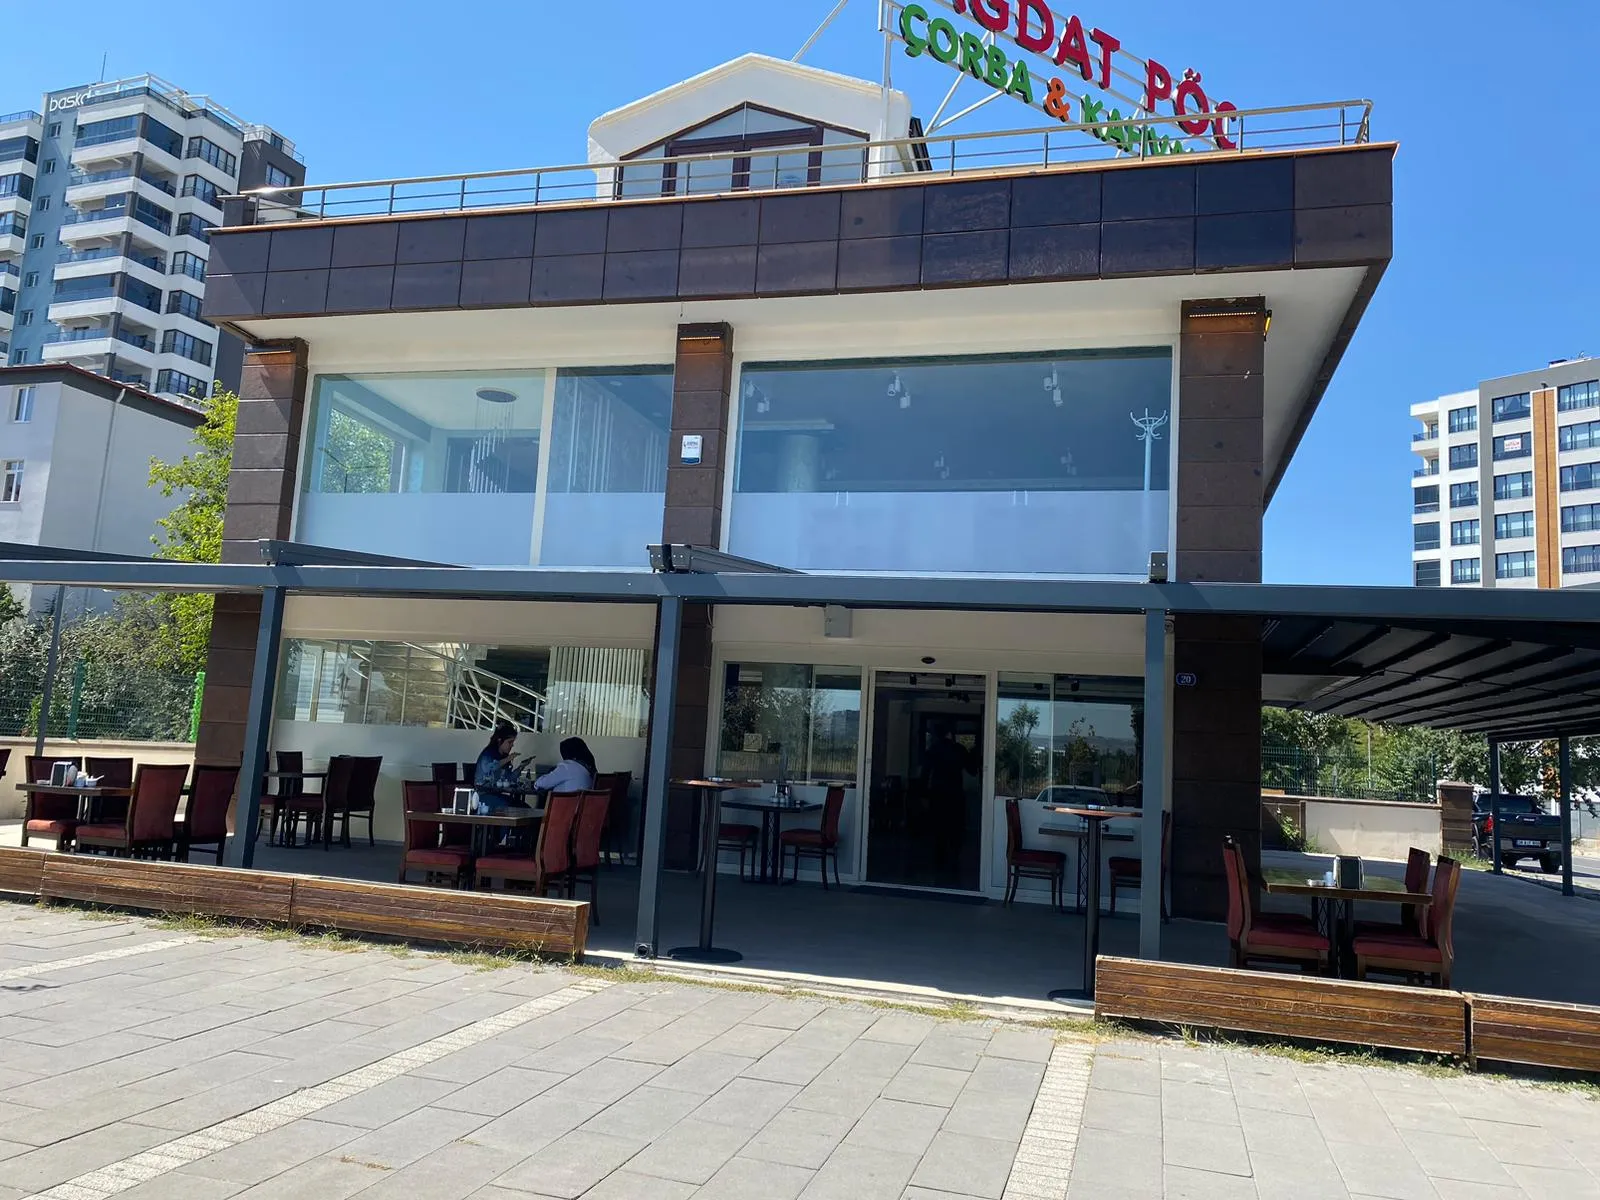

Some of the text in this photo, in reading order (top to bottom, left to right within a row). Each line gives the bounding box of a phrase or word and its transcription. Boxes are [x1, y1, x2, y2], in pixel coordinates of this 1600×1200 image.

[899, 4, 1033, 104] ÇORBA
[1043, 77, 1070, 123] &
[952, 0, 1121, 90] GDAT
[1181, 675, 1192, 684] 20
